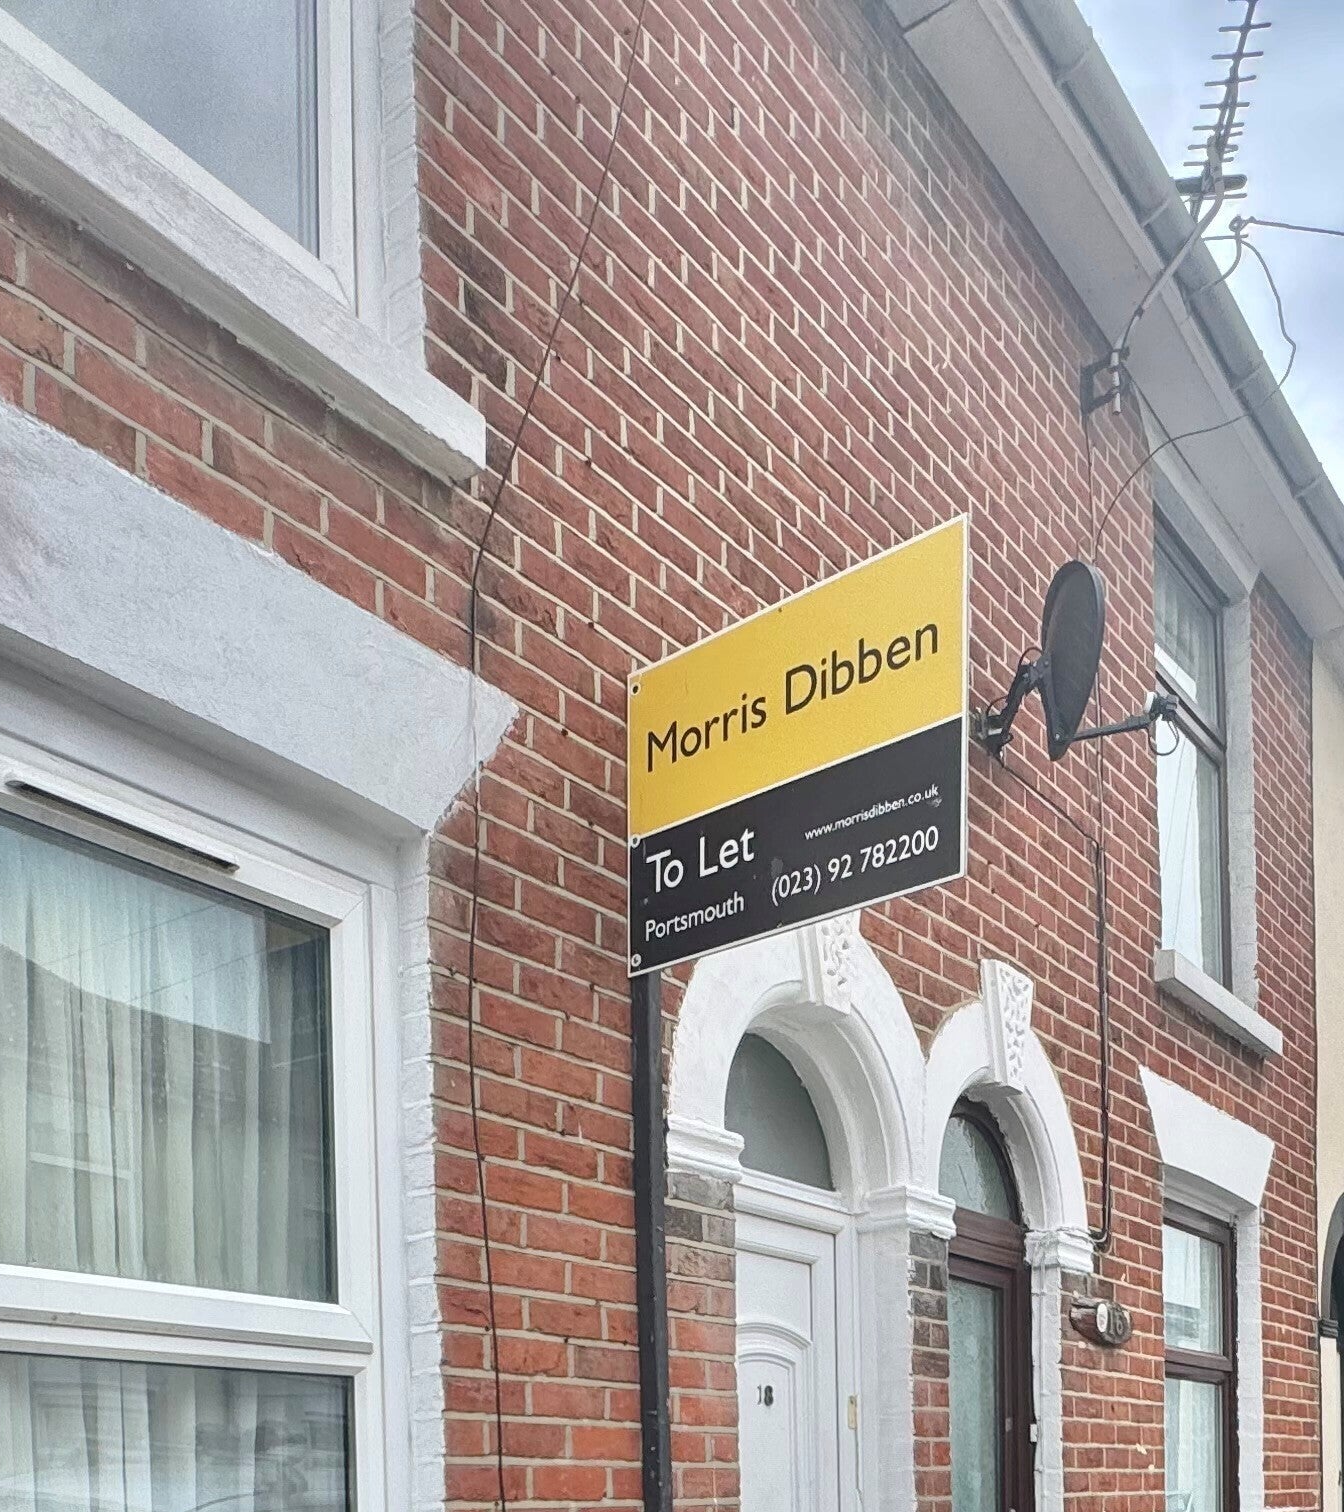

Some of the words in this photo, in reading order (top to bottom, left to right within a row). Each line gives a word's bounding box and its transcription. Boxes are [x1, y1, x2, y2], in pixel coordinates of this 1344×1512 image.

[647, 693, 767, 773] Morris
[785, 623, 938, 715] Dibben
[805, 784, 938, 840] www.morrisdibben.co.uk
[646, 849, 684, 893] To
[699, 828, 754, 878] Let
[771, 863, 821, 907] (023)
[828, 854, 853, 882] 92
[860, 825, 939, 873] 782200
[645, 891, 744, 942] Portsmouth
[757, 1385, 774, 1407] 18
